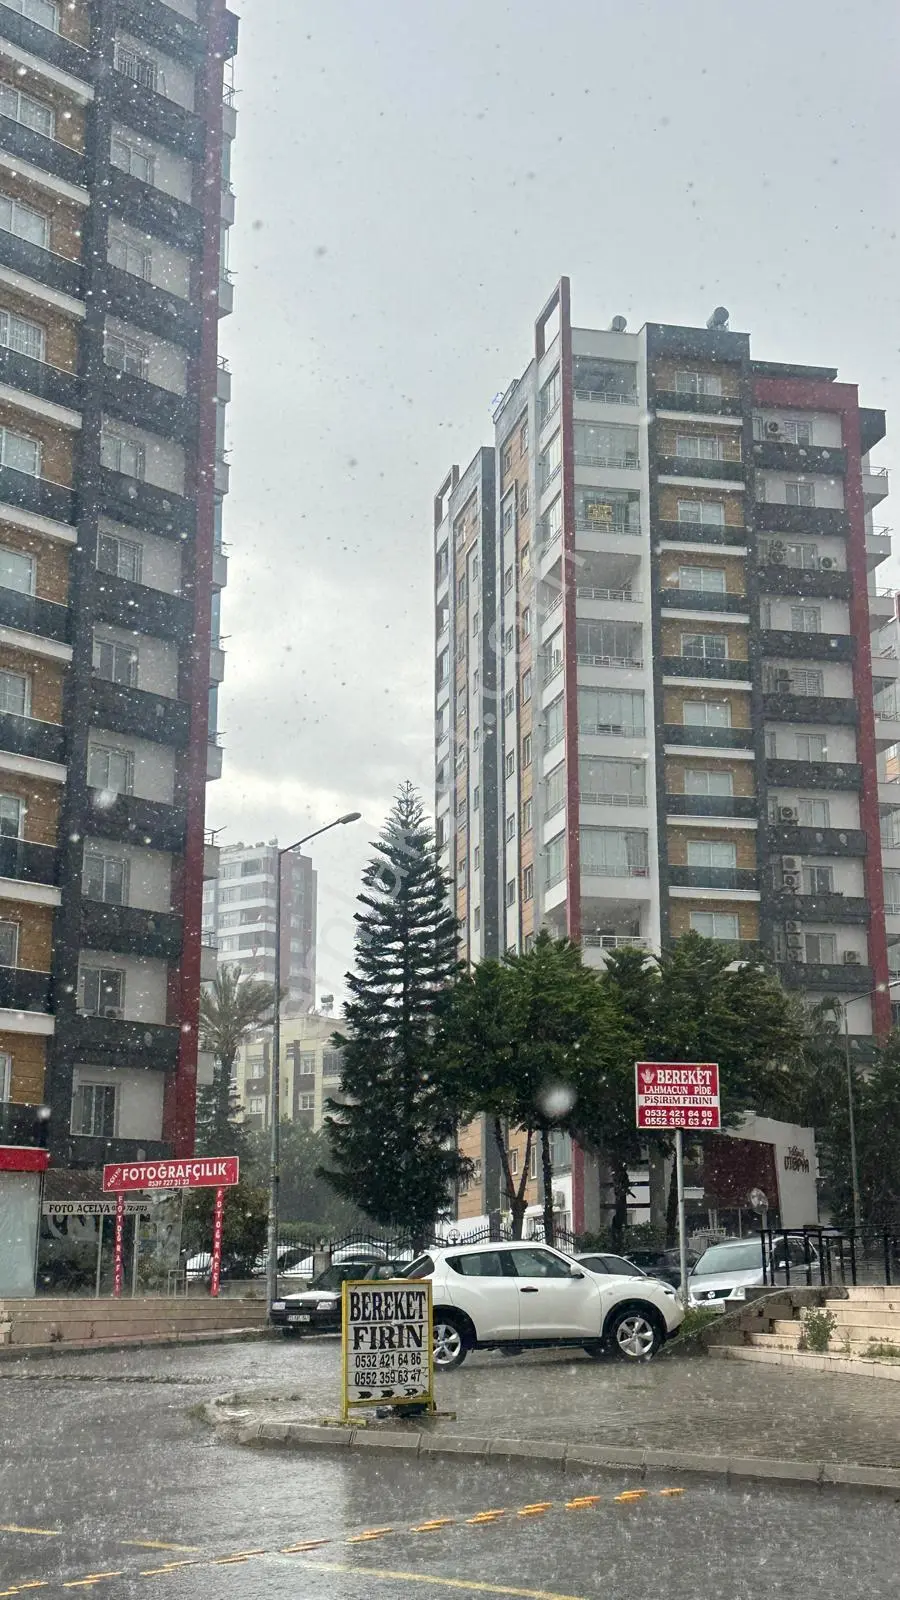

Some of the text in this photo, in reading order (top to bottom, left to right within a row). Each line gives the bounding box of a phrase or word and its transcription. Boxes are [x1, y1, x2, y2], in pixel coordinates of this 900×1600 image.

[656, 1069, 713, 1085] BEREKET
[643, 1085, 689, 1095] LAHMACUN
[644, 1096, 713, 1105] PİŞİRİM FIRINI
[645, 1109, 667, 1117] 0532
[669, 1109, 685, 1117] 421
[688, 1118, 699, 1126] 63
[702, 1118, 713, 1126] 47
[122, 1162, 227, 1181] FOTOĞRAFÇILIK
[49, 1204, 74, 1213] FOTO
[349, 1290, 426, 1322] BEREKET
[353, 1324, 423, 1351] FIRIN
[355, 1352, 421, 1368] 0532 421 64 86
[354, 1369, 421, 1385] 0552 359 63 47
